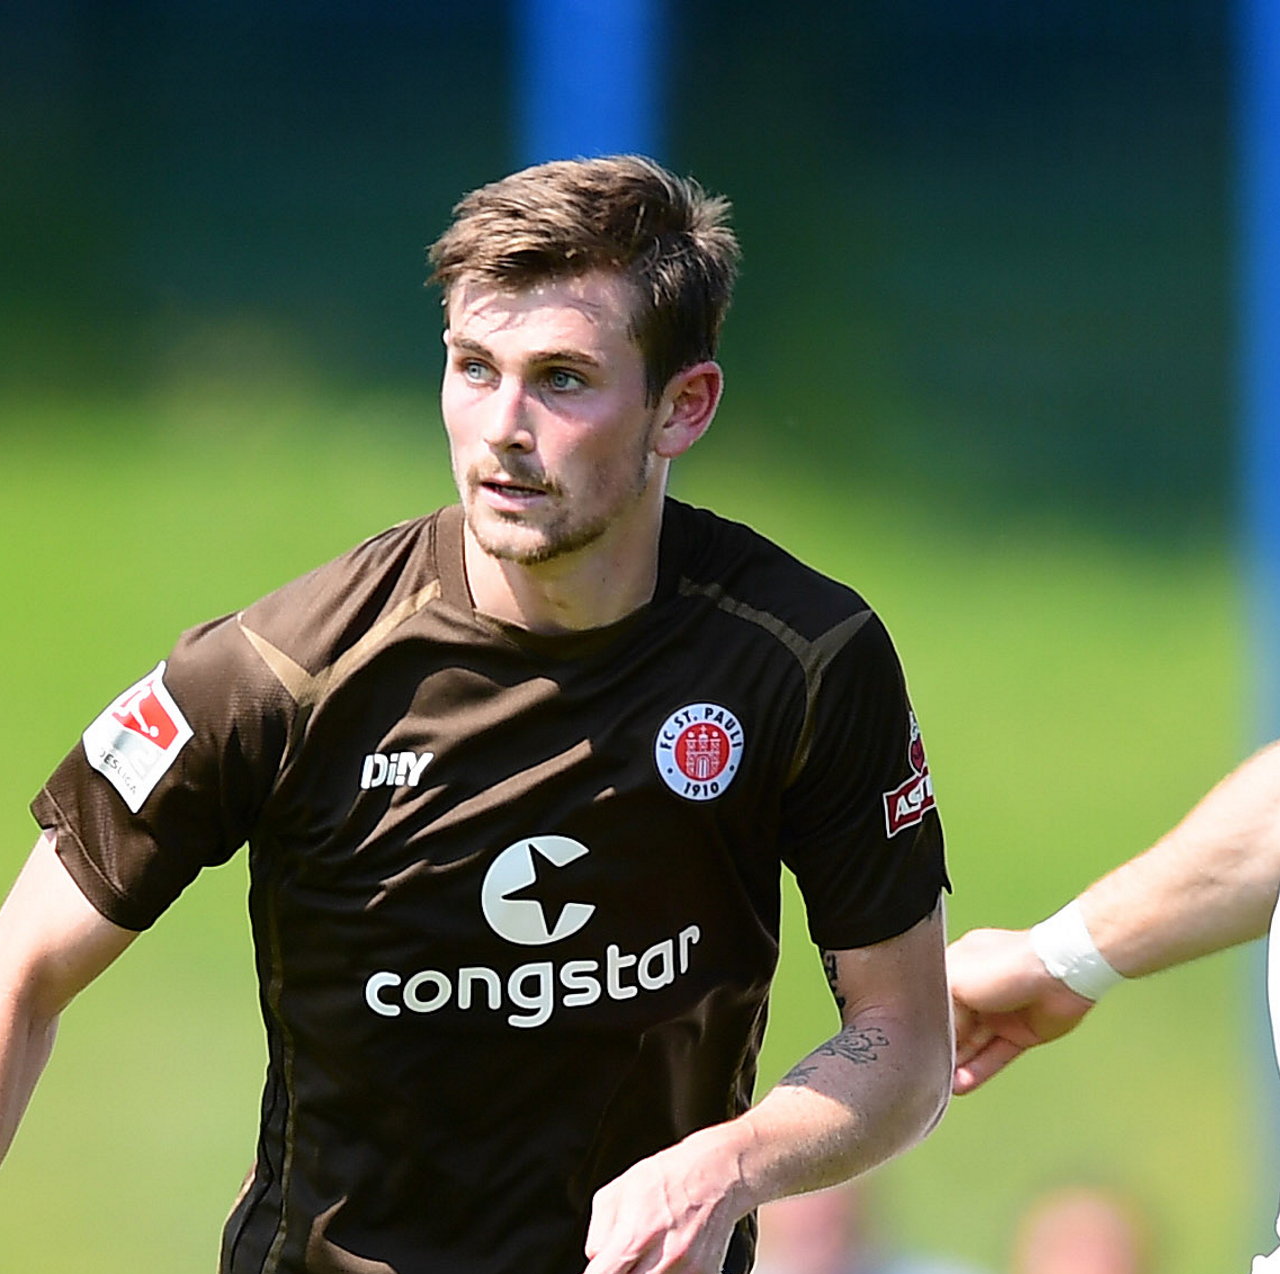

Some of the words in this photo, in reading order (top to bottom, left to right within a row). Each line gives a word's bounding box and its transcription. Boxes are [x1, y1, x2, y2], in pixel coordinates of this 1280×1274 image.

[660, 730, 676, 750] FC
[674, 709, 699, 729] ST.
[704, 707, 743, 748] PAULI
[684, 781, 720, 797] 1910
[365, 925, 701, 1028] congstar
